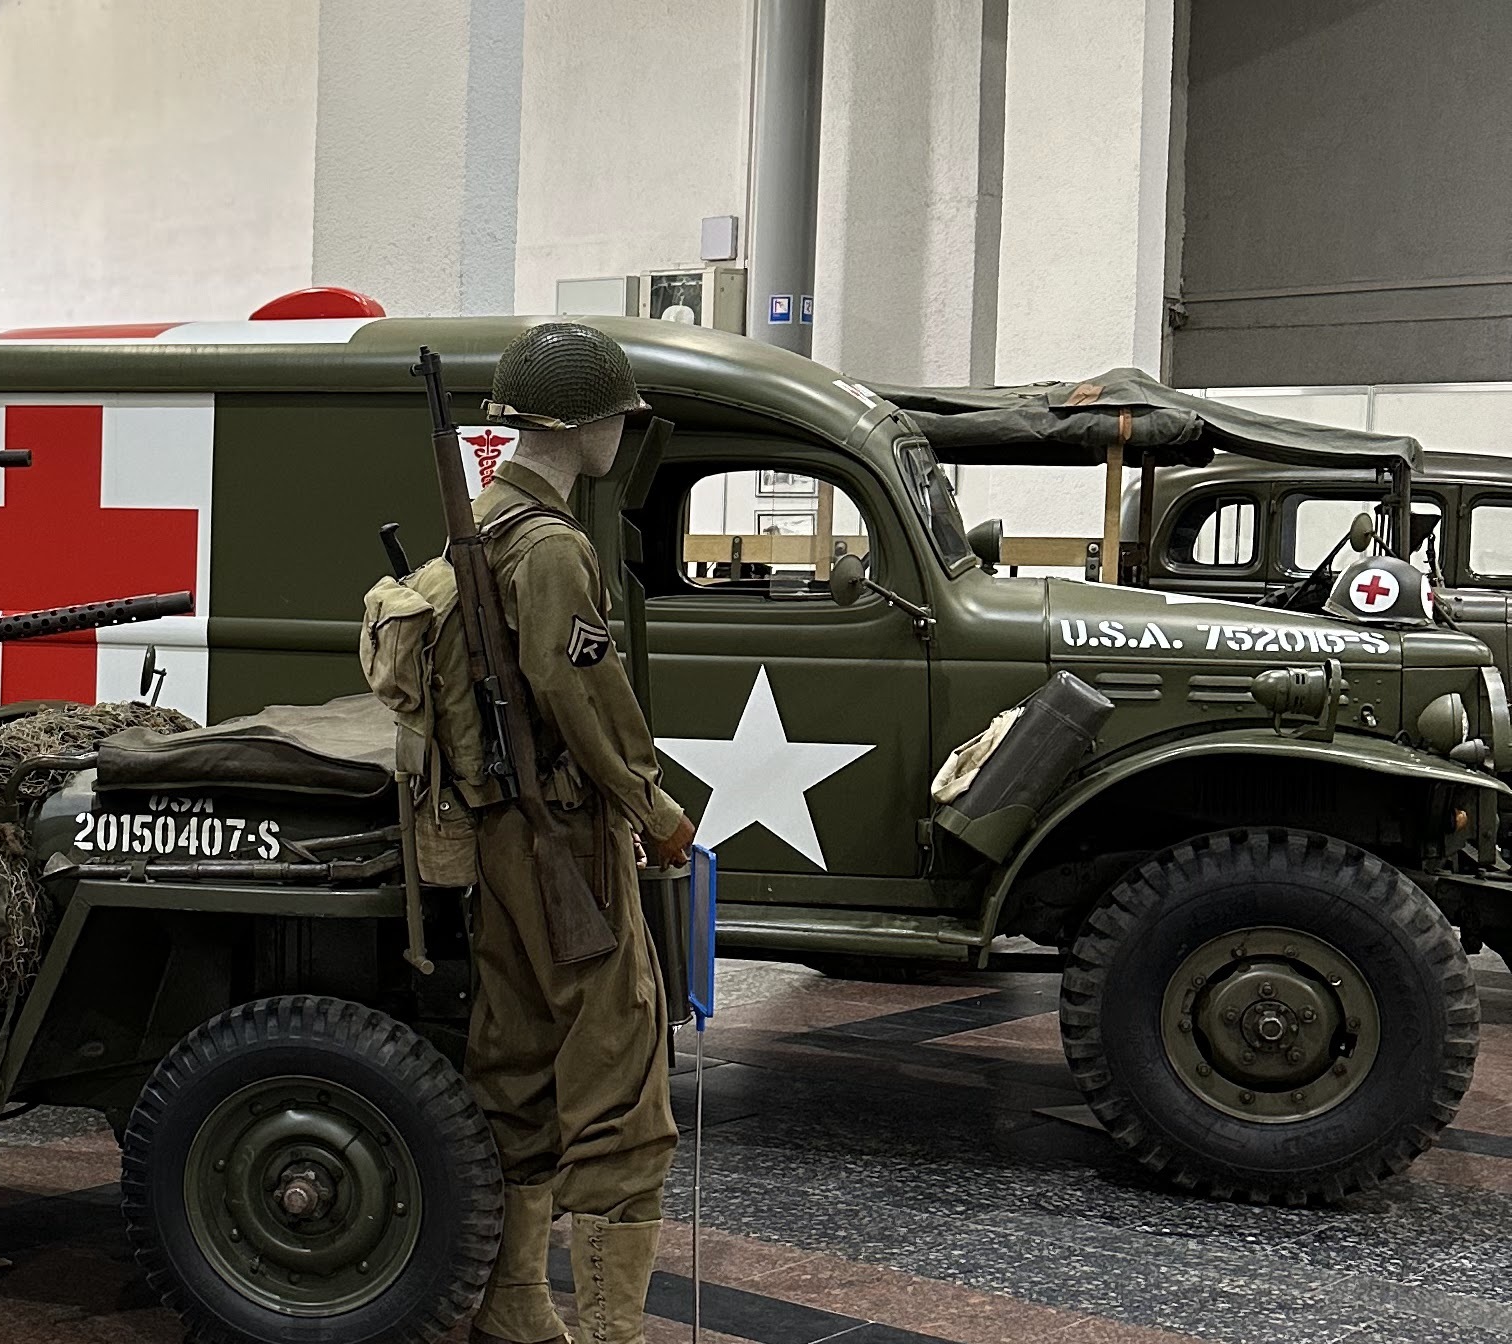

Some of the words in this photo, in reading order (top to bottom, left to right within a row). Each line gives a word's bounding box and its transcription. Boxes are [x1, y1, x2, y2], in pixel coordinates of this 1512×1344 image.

[1059, 619, 1184, 650] U.S.A.
[1196, 624, 1390, 654] 752016-S
[73, 812, 280, 860] 20150407-S
